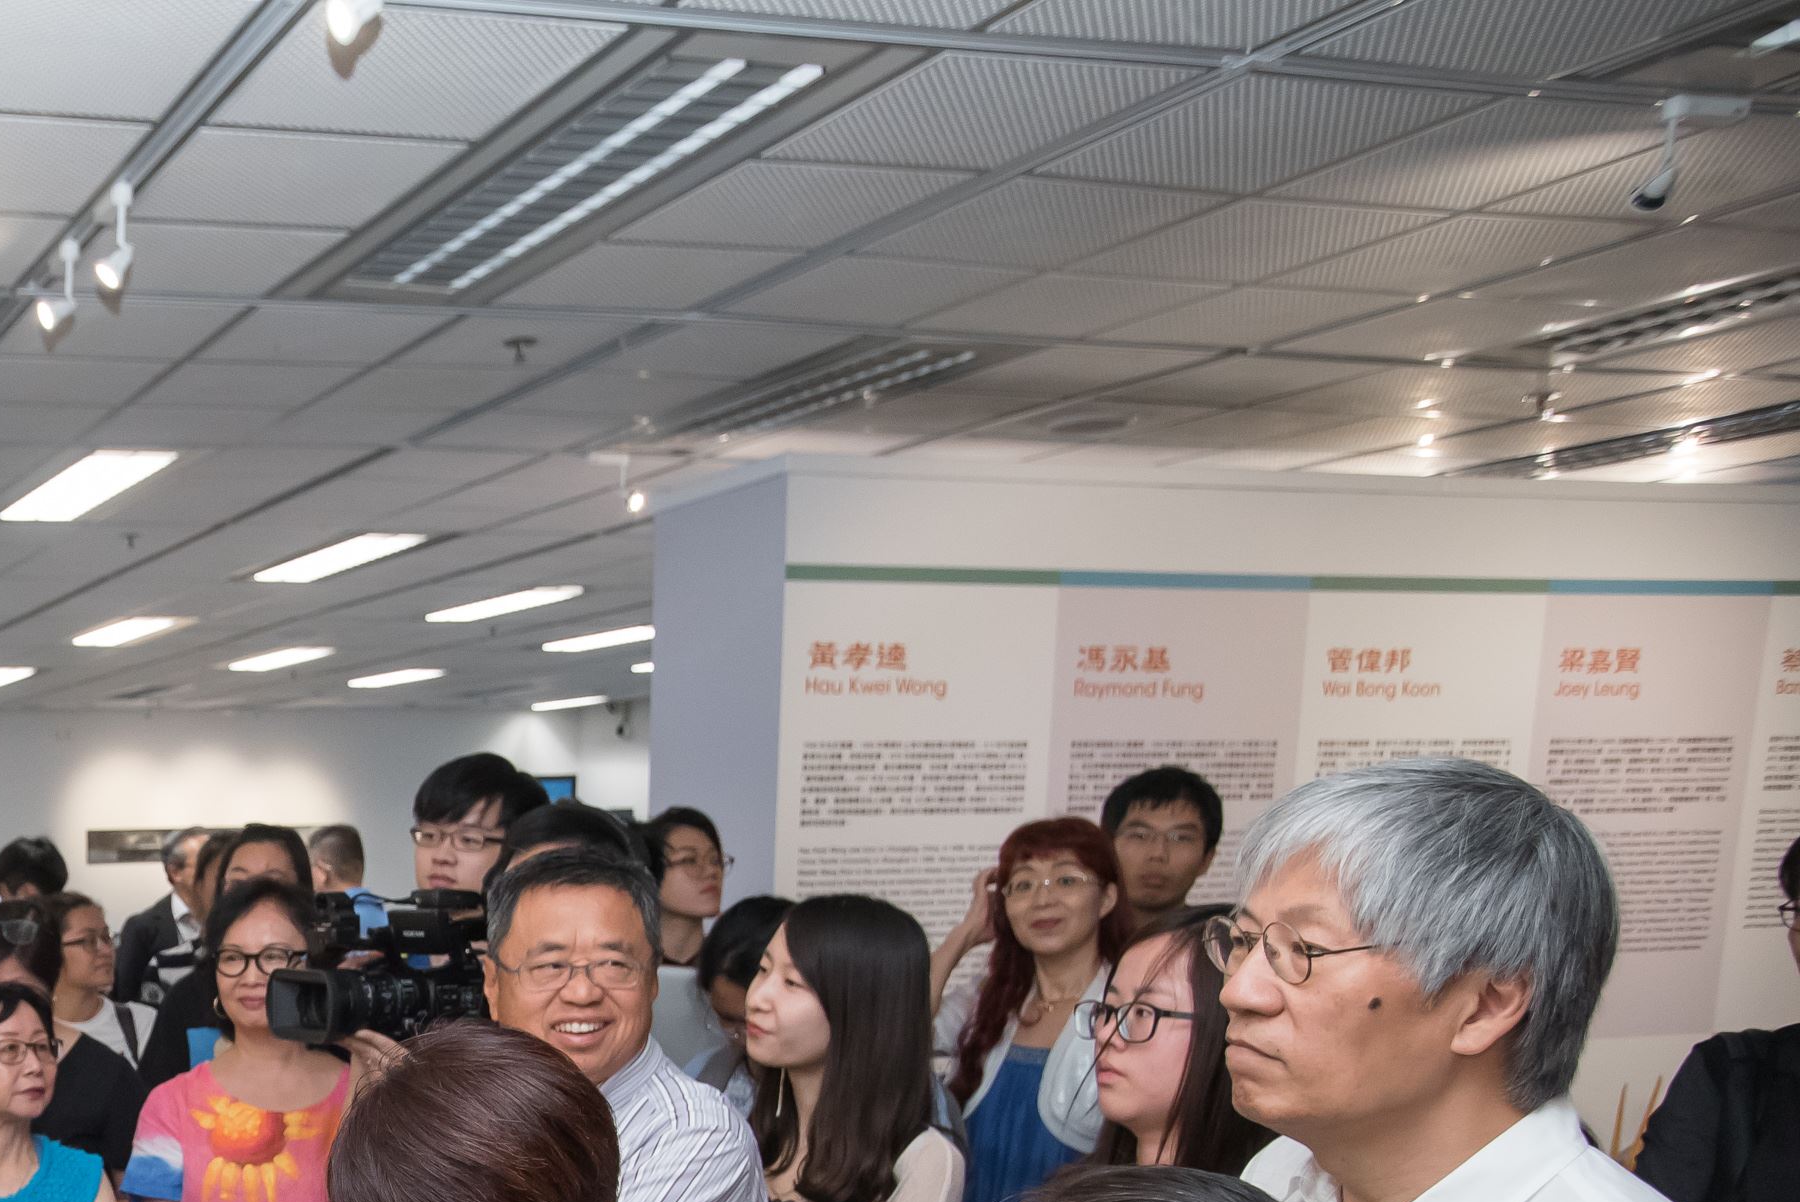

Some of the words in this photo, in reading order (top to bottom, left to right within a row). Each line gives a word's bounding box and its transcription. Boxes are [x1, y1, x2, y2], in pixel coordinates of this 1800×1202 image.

[1076, 645, 1171, 673] 馮永基
[1327, 647, 1412, 674] 管偉邦
[1559, 647, 1641, 674] 梁嘉賢
[805, 677, 843, 696] Hau
[848, 677, 891, 696] Kwei
[895, 678, 948, 701] Wong
[1073, 678, 1157, 701] Raymond
[1161, 679, 1204, 703] Fung
[1322, 681, 1352, 697] Wai
[1355, 681, 1397, 702] Bong
[1401, 681, 1441, 697] Koon
[1554, 681, 1589, 699] Joey
[1593, 681, 1641, 701] Leung
